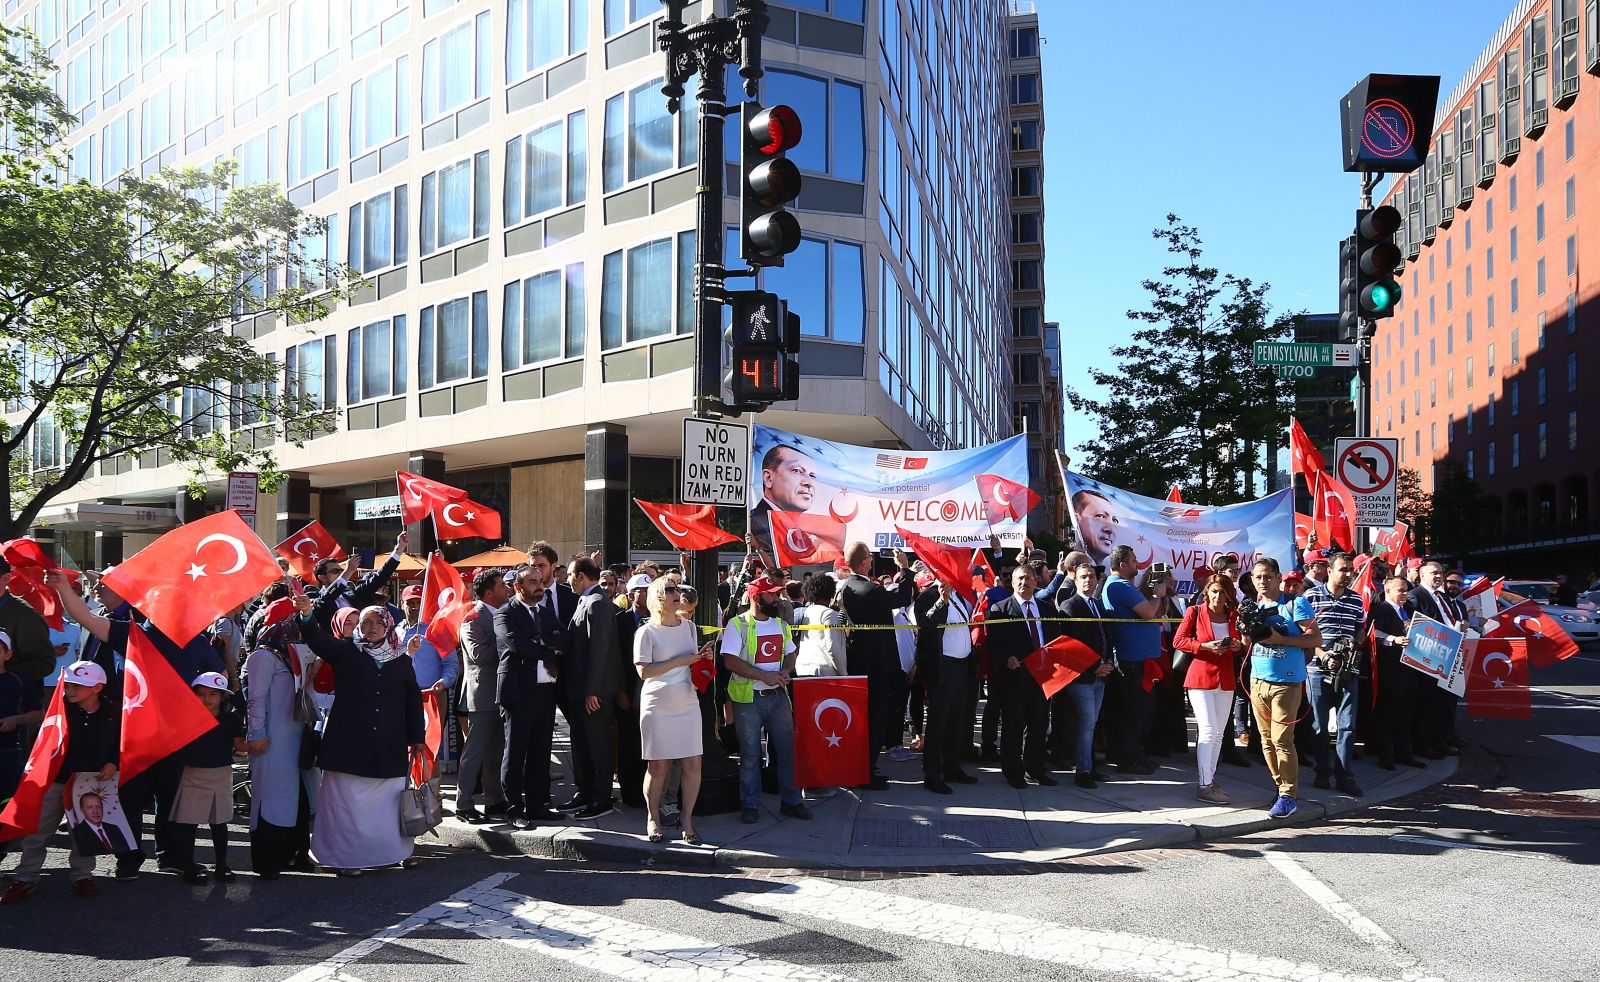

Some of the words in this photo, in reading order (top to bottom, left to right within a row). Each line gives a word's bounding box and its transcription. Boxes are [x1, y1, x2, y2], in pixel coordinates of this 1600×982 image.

[1257, 345, 1319, 362] PENNSYLVANIA
[742, 360, 778, 388] 41
[1281, 366, 1314, 377] 1700
[706, 428, 728, 444] NO
[698, 445, 735, 463] TURN
[688, 463, 709, 480] ON
[715, 465, 742, 482] RED
[687, 481, 743, 500] 7AM-7PM
[896, 484, 930, 493] potential
[878, 500, 989, 522] WELCOME
[925, 535, 983, 544] TERNATIONAL
[1167, 528, 1199, 536] Discover
[1414, 633, 1453, 661] TURKEY
